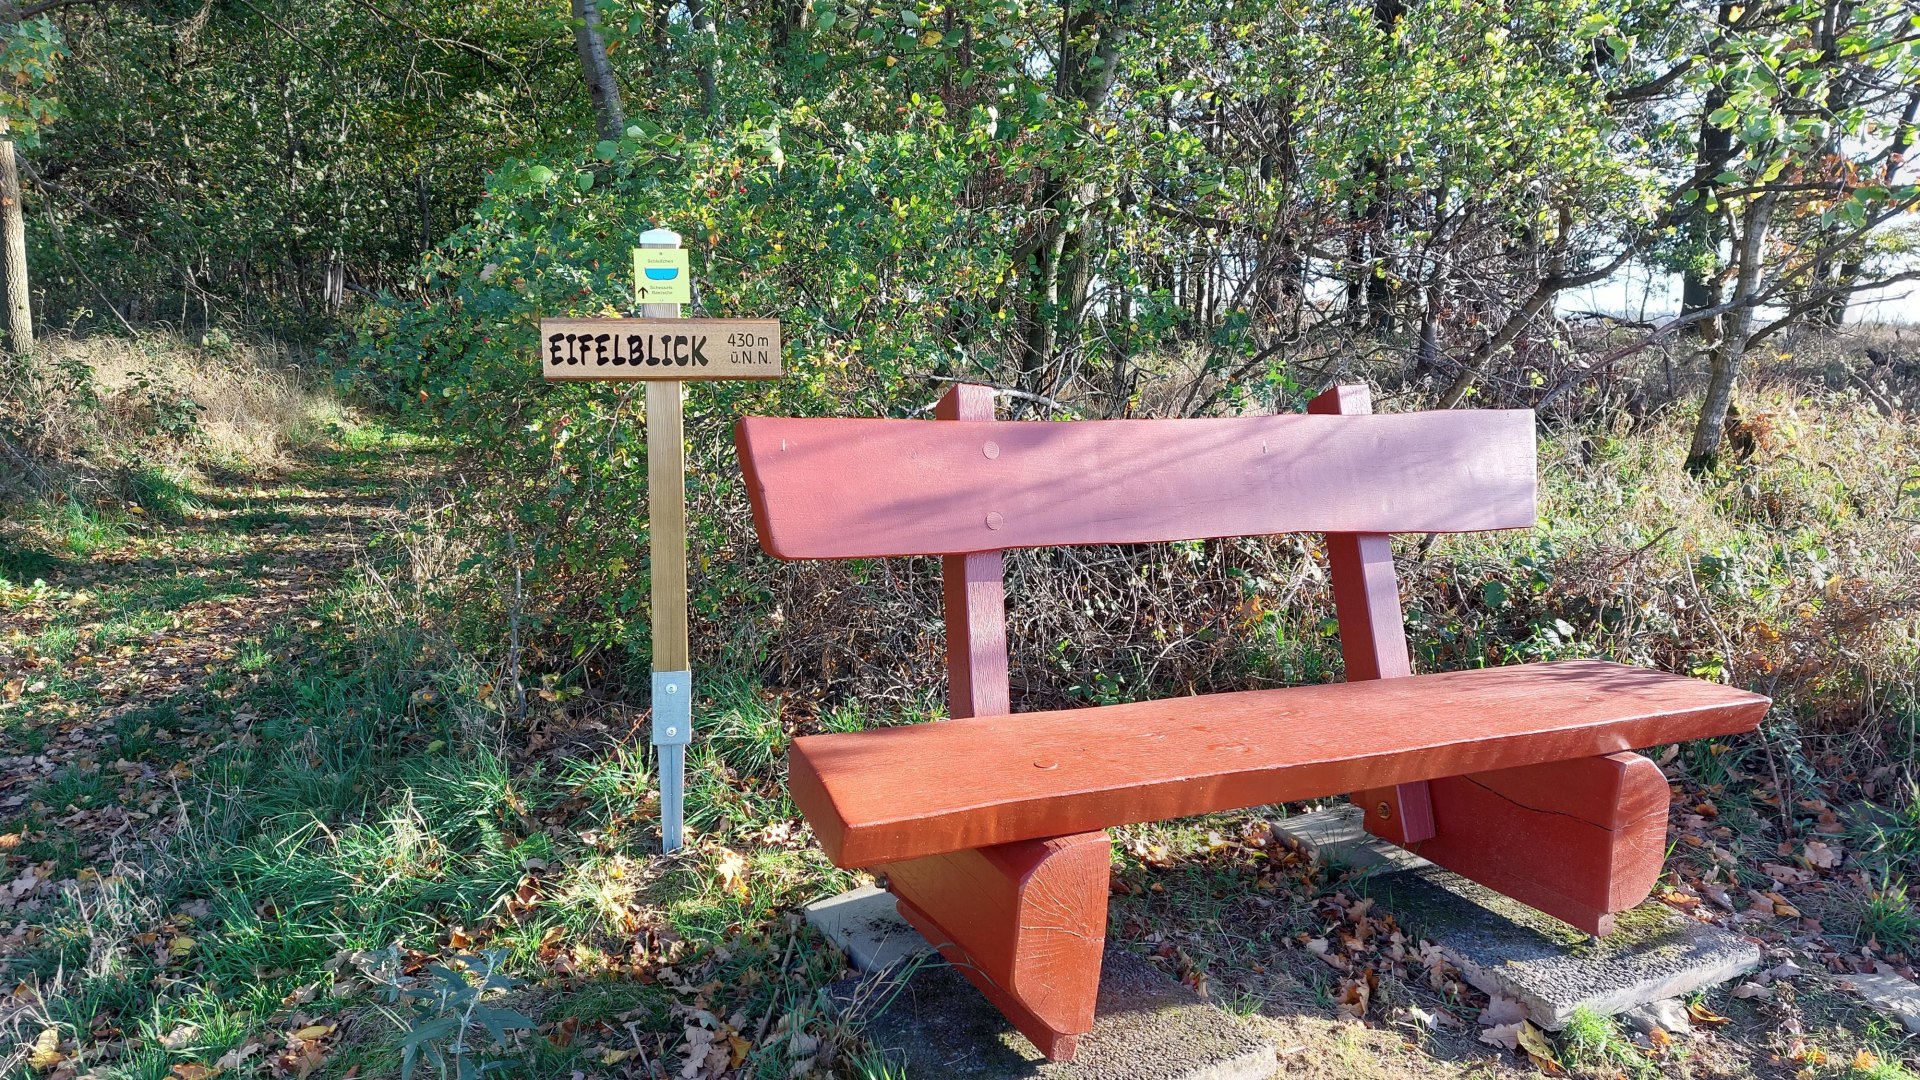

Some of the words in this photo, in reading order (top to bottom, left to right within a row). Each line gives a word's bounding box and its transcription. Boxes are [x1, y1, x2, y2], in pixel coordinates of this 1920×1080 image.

[548, 332, 709, 366] EIFELBLICK
[727, 333, 755, 347] 430
[757, 336, 769, 347] m
